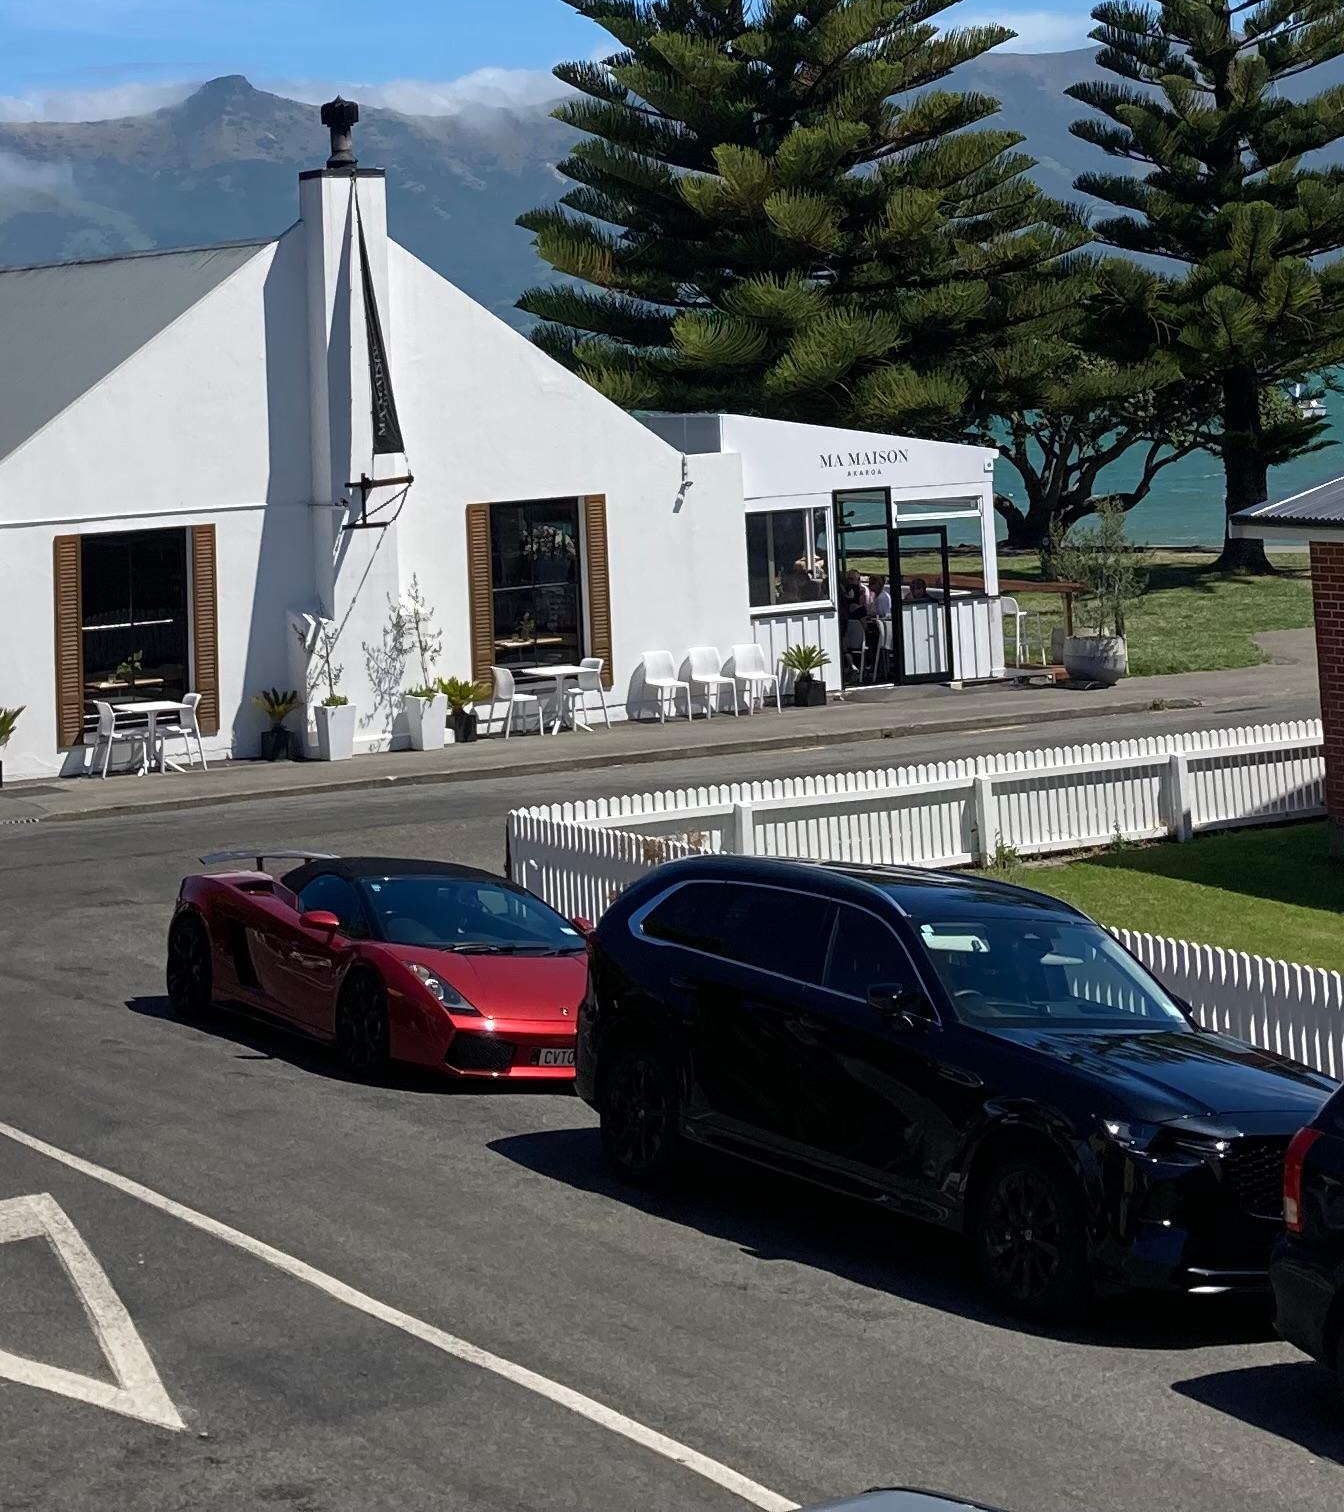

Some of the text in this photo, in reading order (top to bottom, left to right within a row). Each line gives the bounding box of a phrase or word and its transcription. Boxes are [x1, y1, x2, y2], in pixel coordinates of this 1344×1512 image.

[819, 449, 909, 468] MA MAISON
[847, 469, 882, 477] AKAROA
